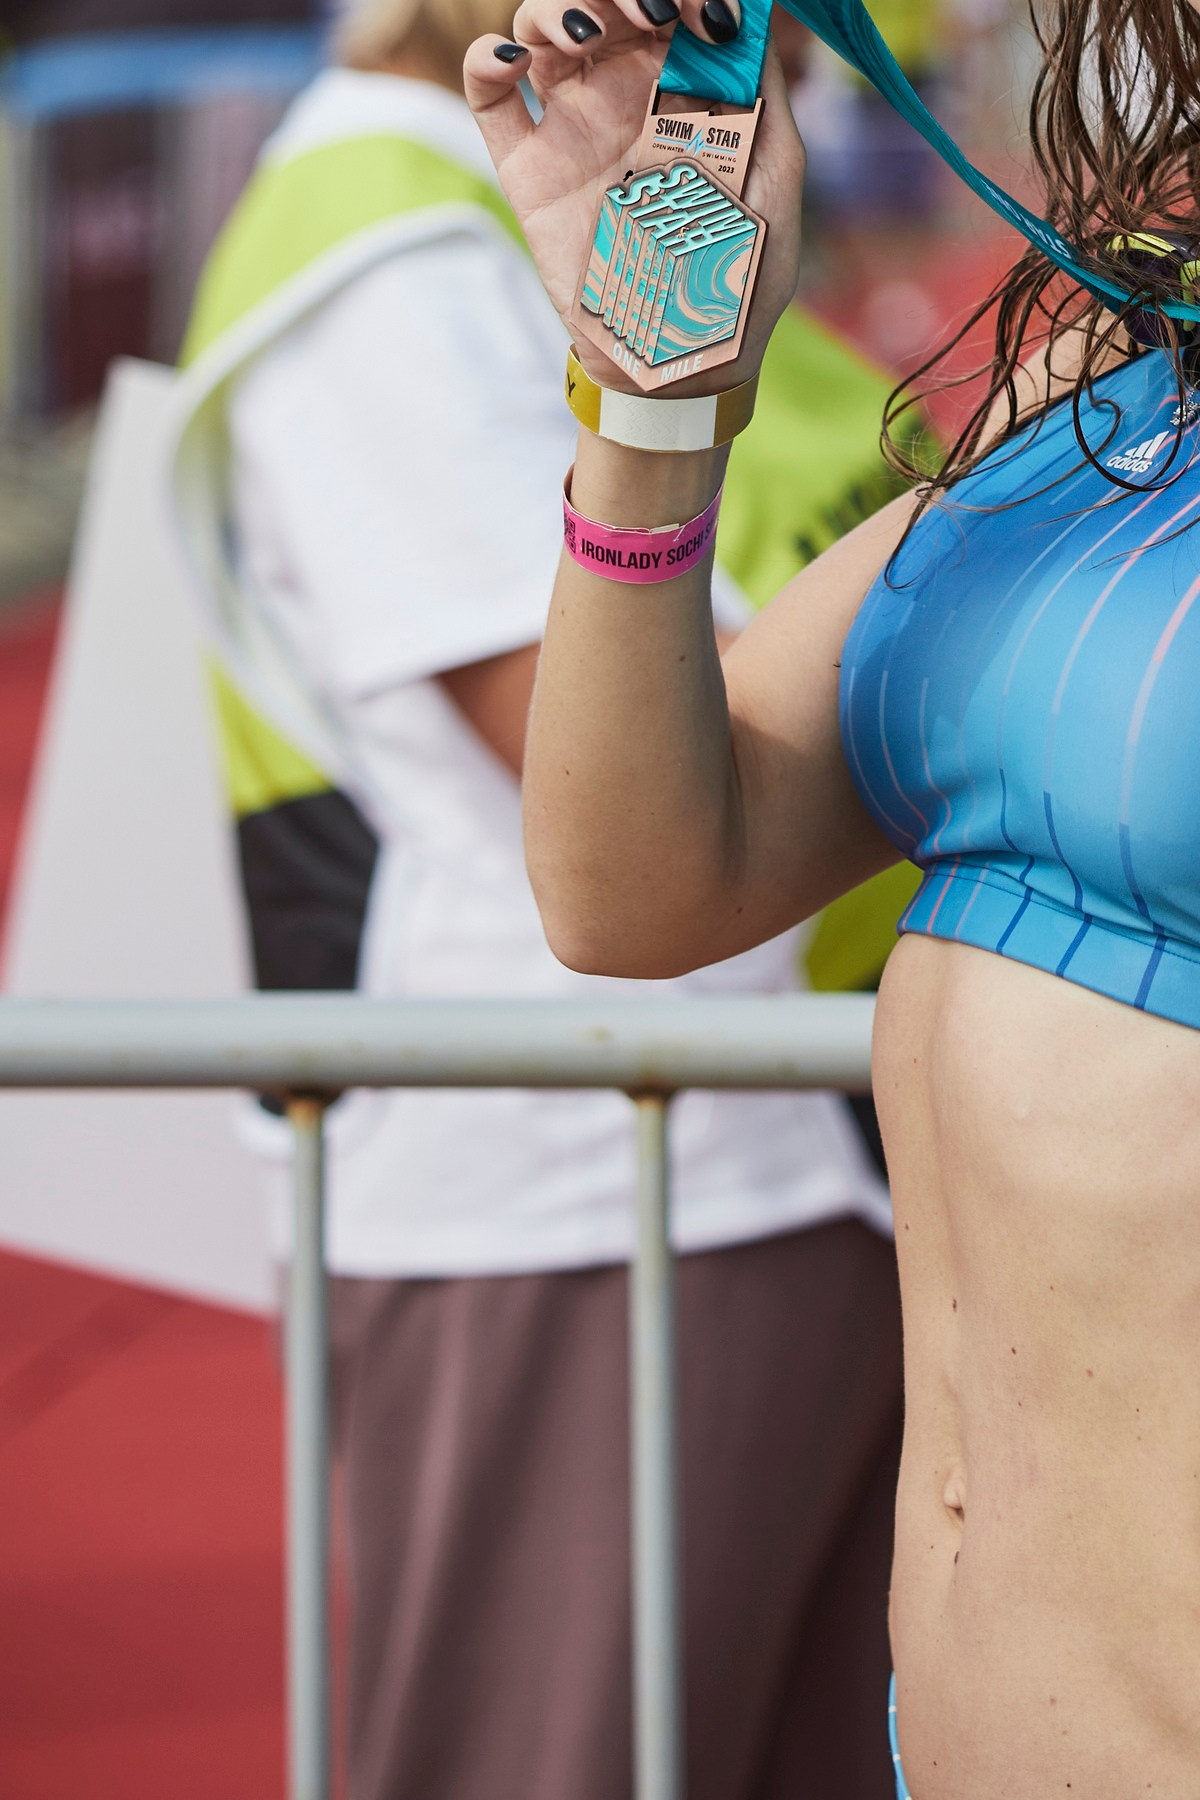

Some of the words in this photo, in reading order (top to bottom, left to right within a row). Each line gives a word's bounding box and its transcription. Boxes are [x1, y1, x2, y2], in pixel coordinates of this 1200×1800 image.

[655, 118, 694, 140] SWIM
[706, 127, 741, 149] STAR
[652, 142, 667, 150] OPEN
[667, 145, 685, 153] WATER
[702, 152, 737, 163] SWIMMING
[718, 165, 735, 174] 2023
[605, 172, 714, 257] STAR
[659, 165, 757, 238] SWIM
[612, 342, 642, 378] ONE
[660, 354, 704, 383] MILE
[1106, 455, 1152, 473] adidas
[581, 538, 662, 570] IRONLADY
[666, 530, 704, 566] SOCHI
